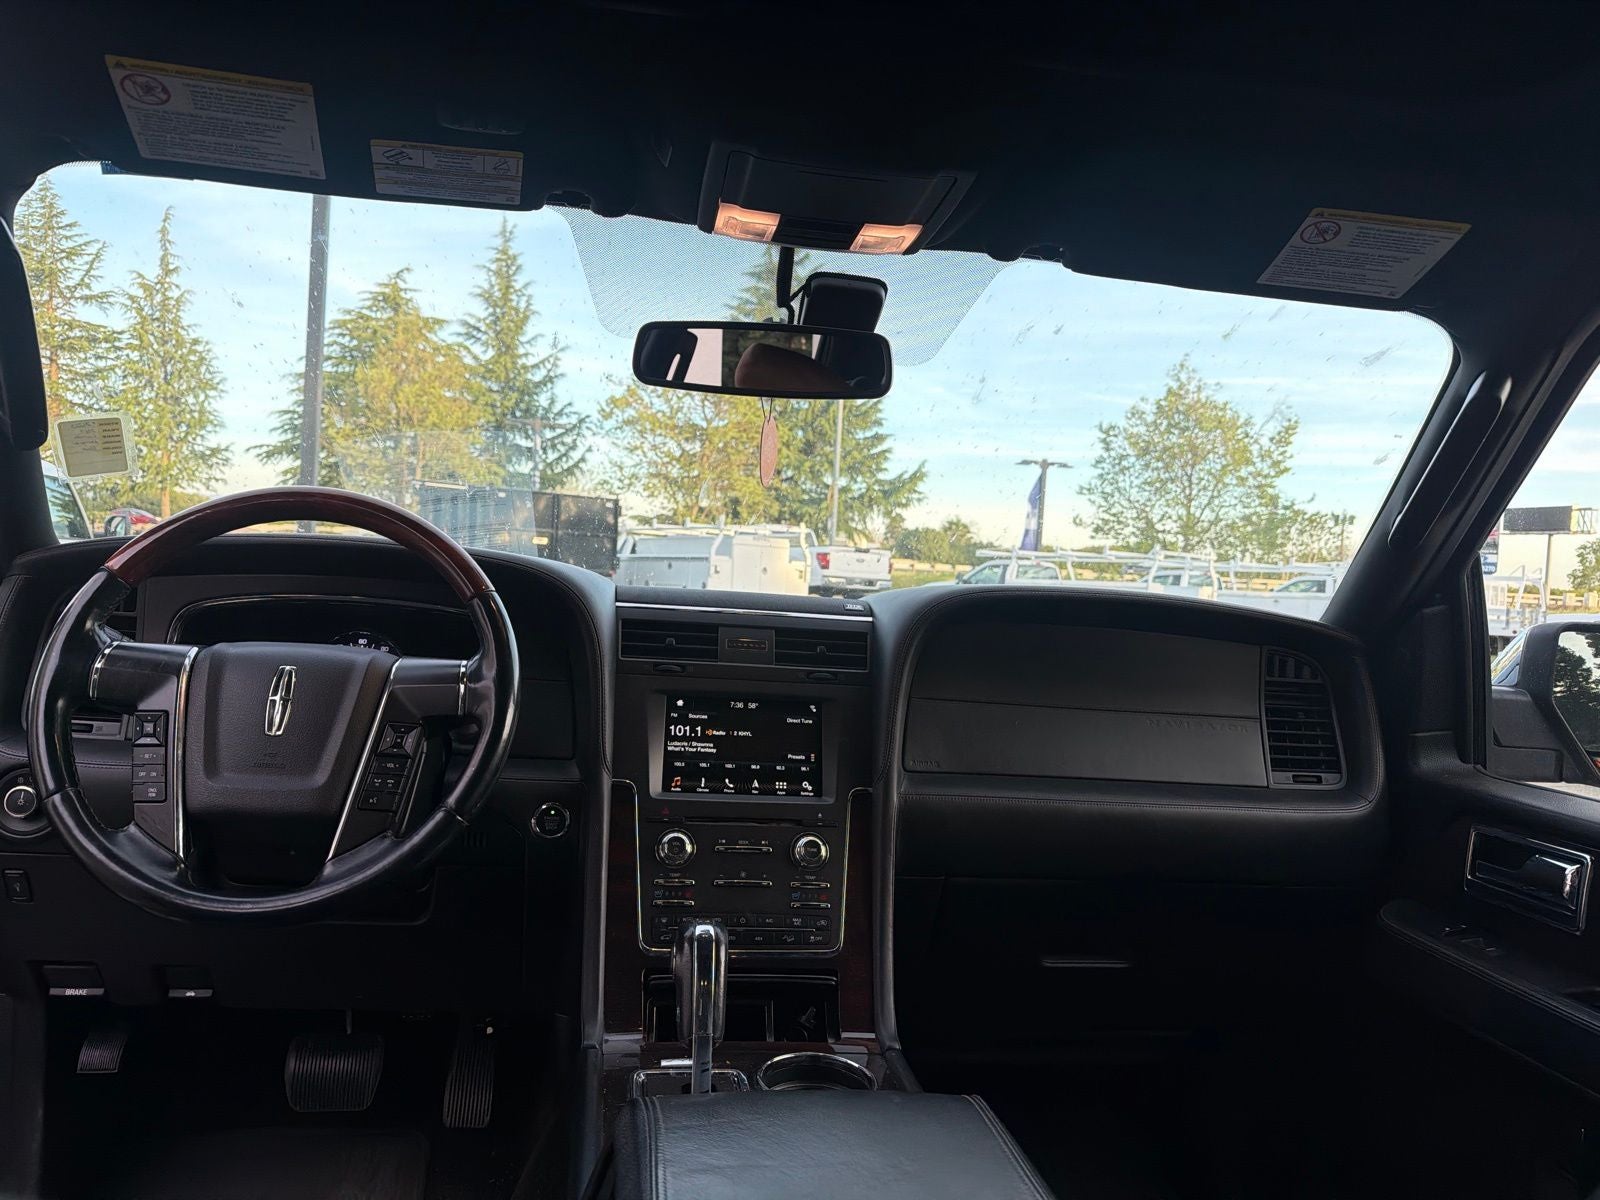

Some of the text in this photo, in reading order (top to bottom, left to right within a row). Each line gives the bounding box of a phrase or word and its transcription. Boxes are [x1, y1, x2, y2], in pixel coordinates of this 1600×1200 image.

[729, 701, 759, 709] 7:36 58°
[688, 712, 708, 720] Sources
[801, 717, 813, 725] Tune
[668, 725, 702, 737] 101.1
[64, 988, 88, 996] BRAKE
